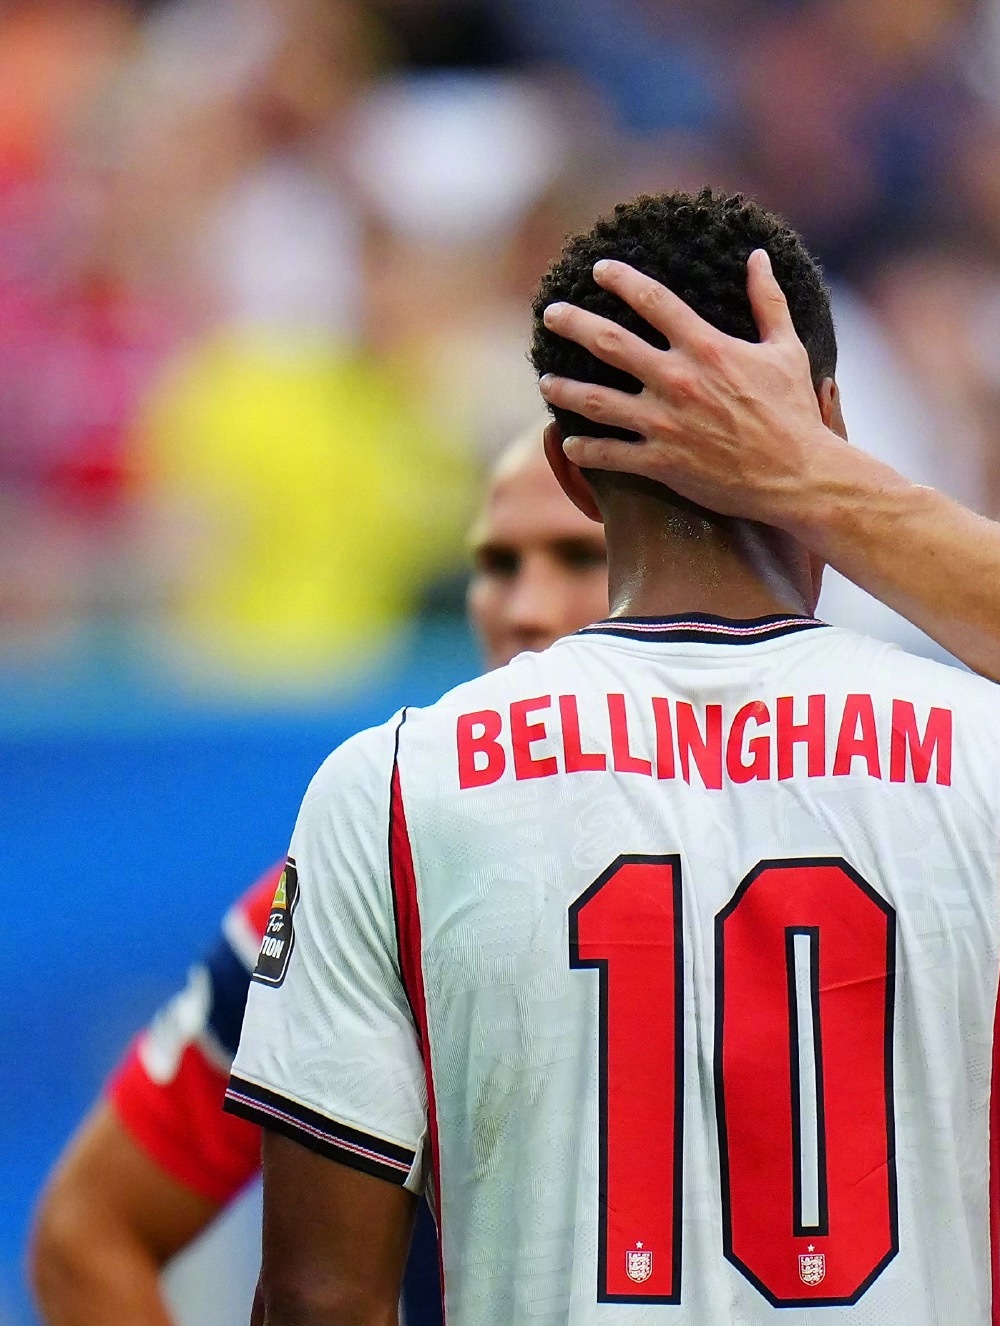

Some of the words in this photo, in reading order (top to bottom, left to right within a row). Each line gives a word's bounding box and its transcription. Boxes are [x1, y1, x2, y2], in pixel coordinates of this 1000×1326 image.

[457, 693, 952, 790] BELLINGHAM
[269, 913, 285, 933] For
[568, 853, 900, 1308] 10
